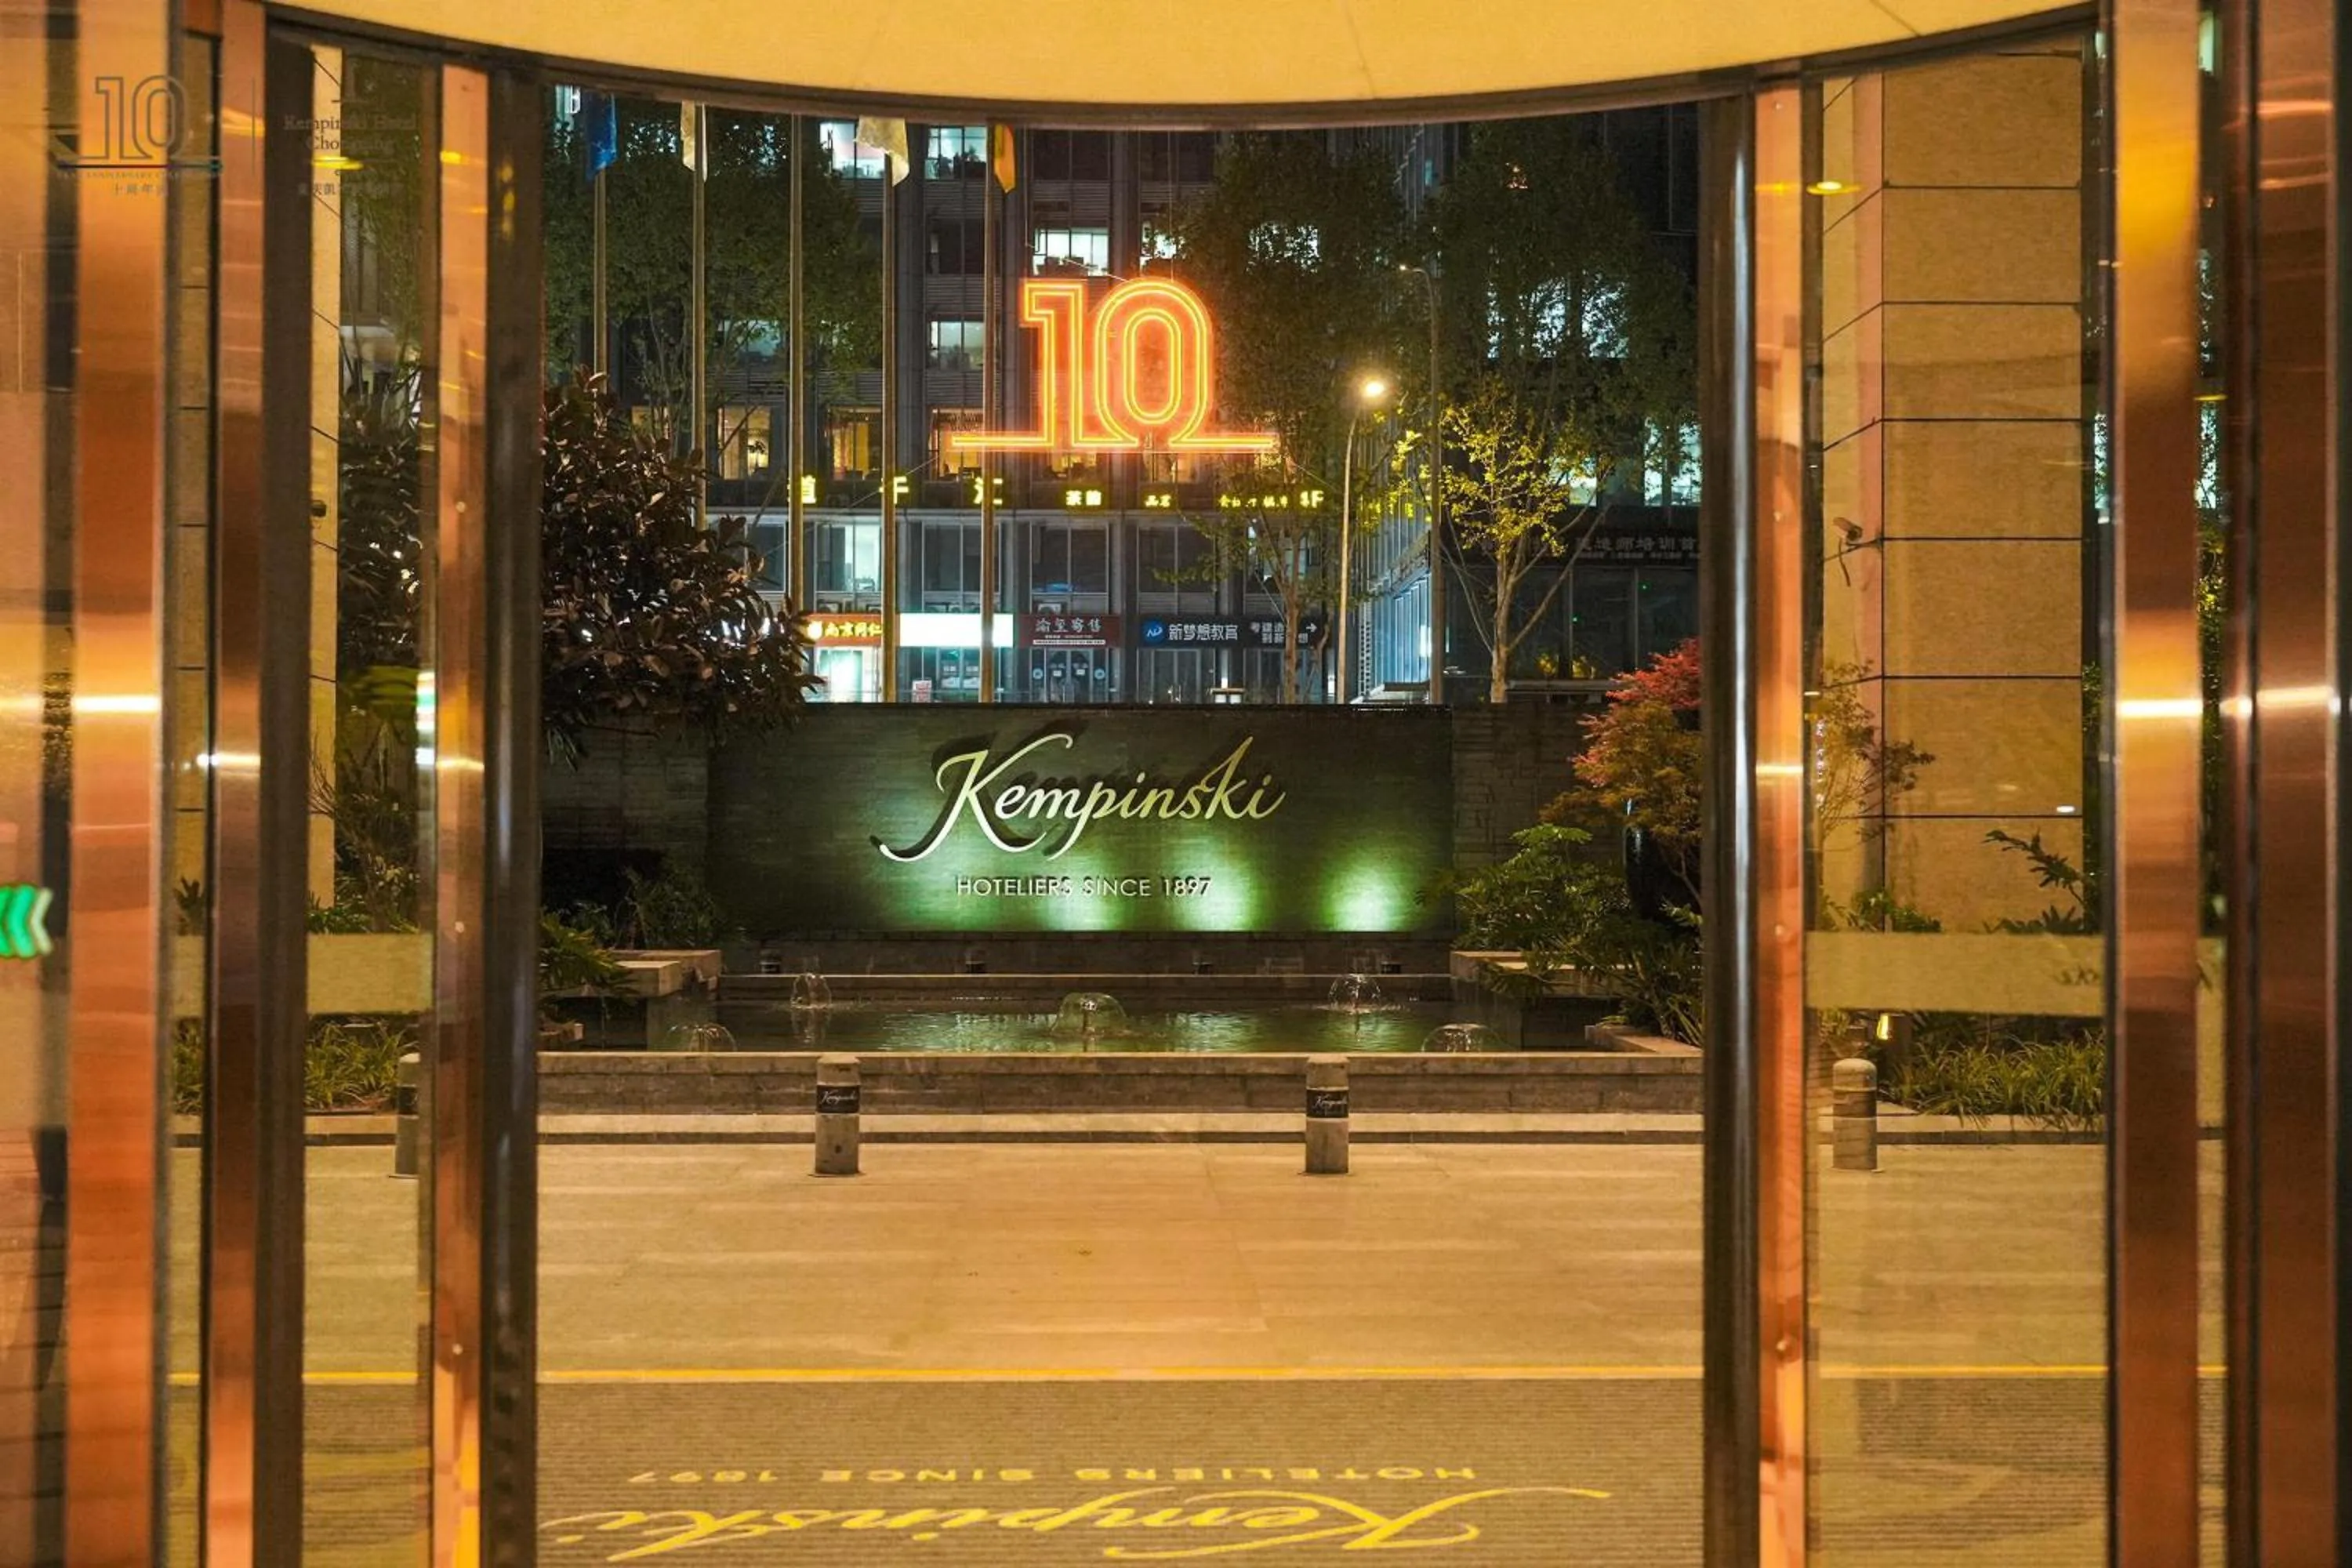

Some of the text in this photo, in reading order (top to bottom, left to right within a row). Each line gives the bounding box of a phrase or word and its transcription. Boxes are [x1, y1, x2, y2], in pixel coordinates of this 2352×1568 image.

[1024, 281, 1210, 447] 10
[1169, 623, 1239, 641] 新梦想教育
[879, 733, 1287, 862] Kempinski
[956, 878, 1211, 897] HOTELIERS SINCE 1897
[630, 1467, 1474, 1481] HOTELIERS SINCE 1897
[539, 1487, 1610, 1562] Kempinski
